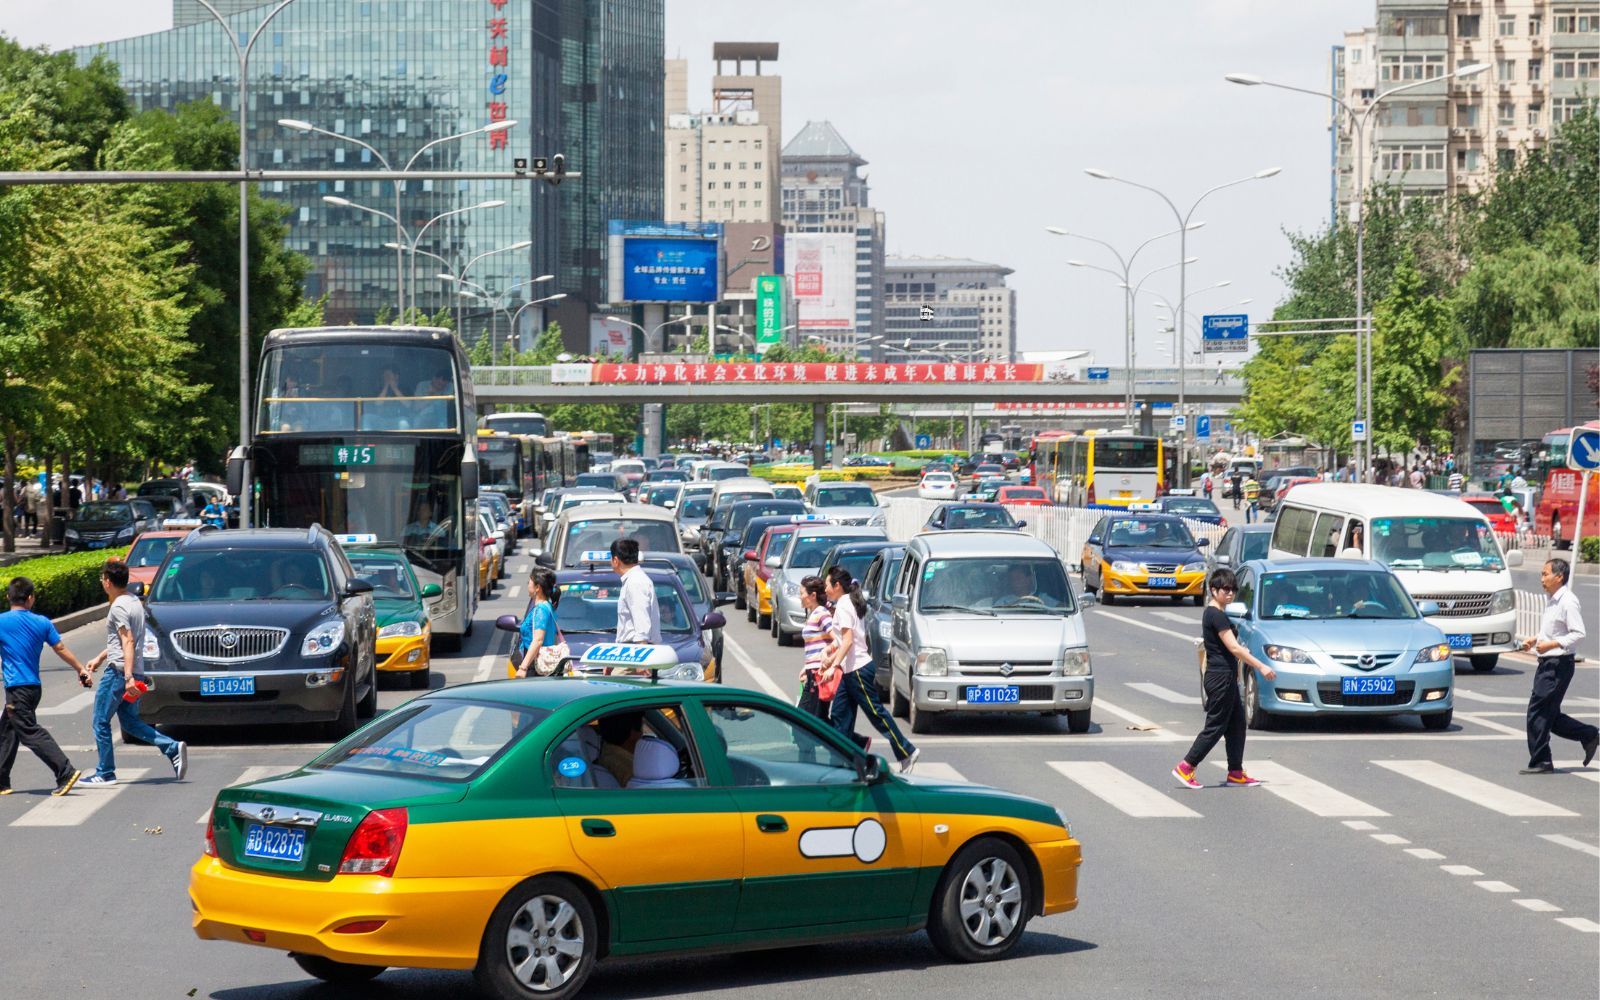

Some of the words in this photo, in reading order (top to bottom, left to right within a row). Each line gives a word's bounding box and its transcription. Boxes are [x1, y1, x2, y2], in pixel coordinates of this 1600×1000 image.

[614, 365, 807, 381] 大力净化社会文化环境
[825, 365, 1017, 381] 促进未成年人健康成长
